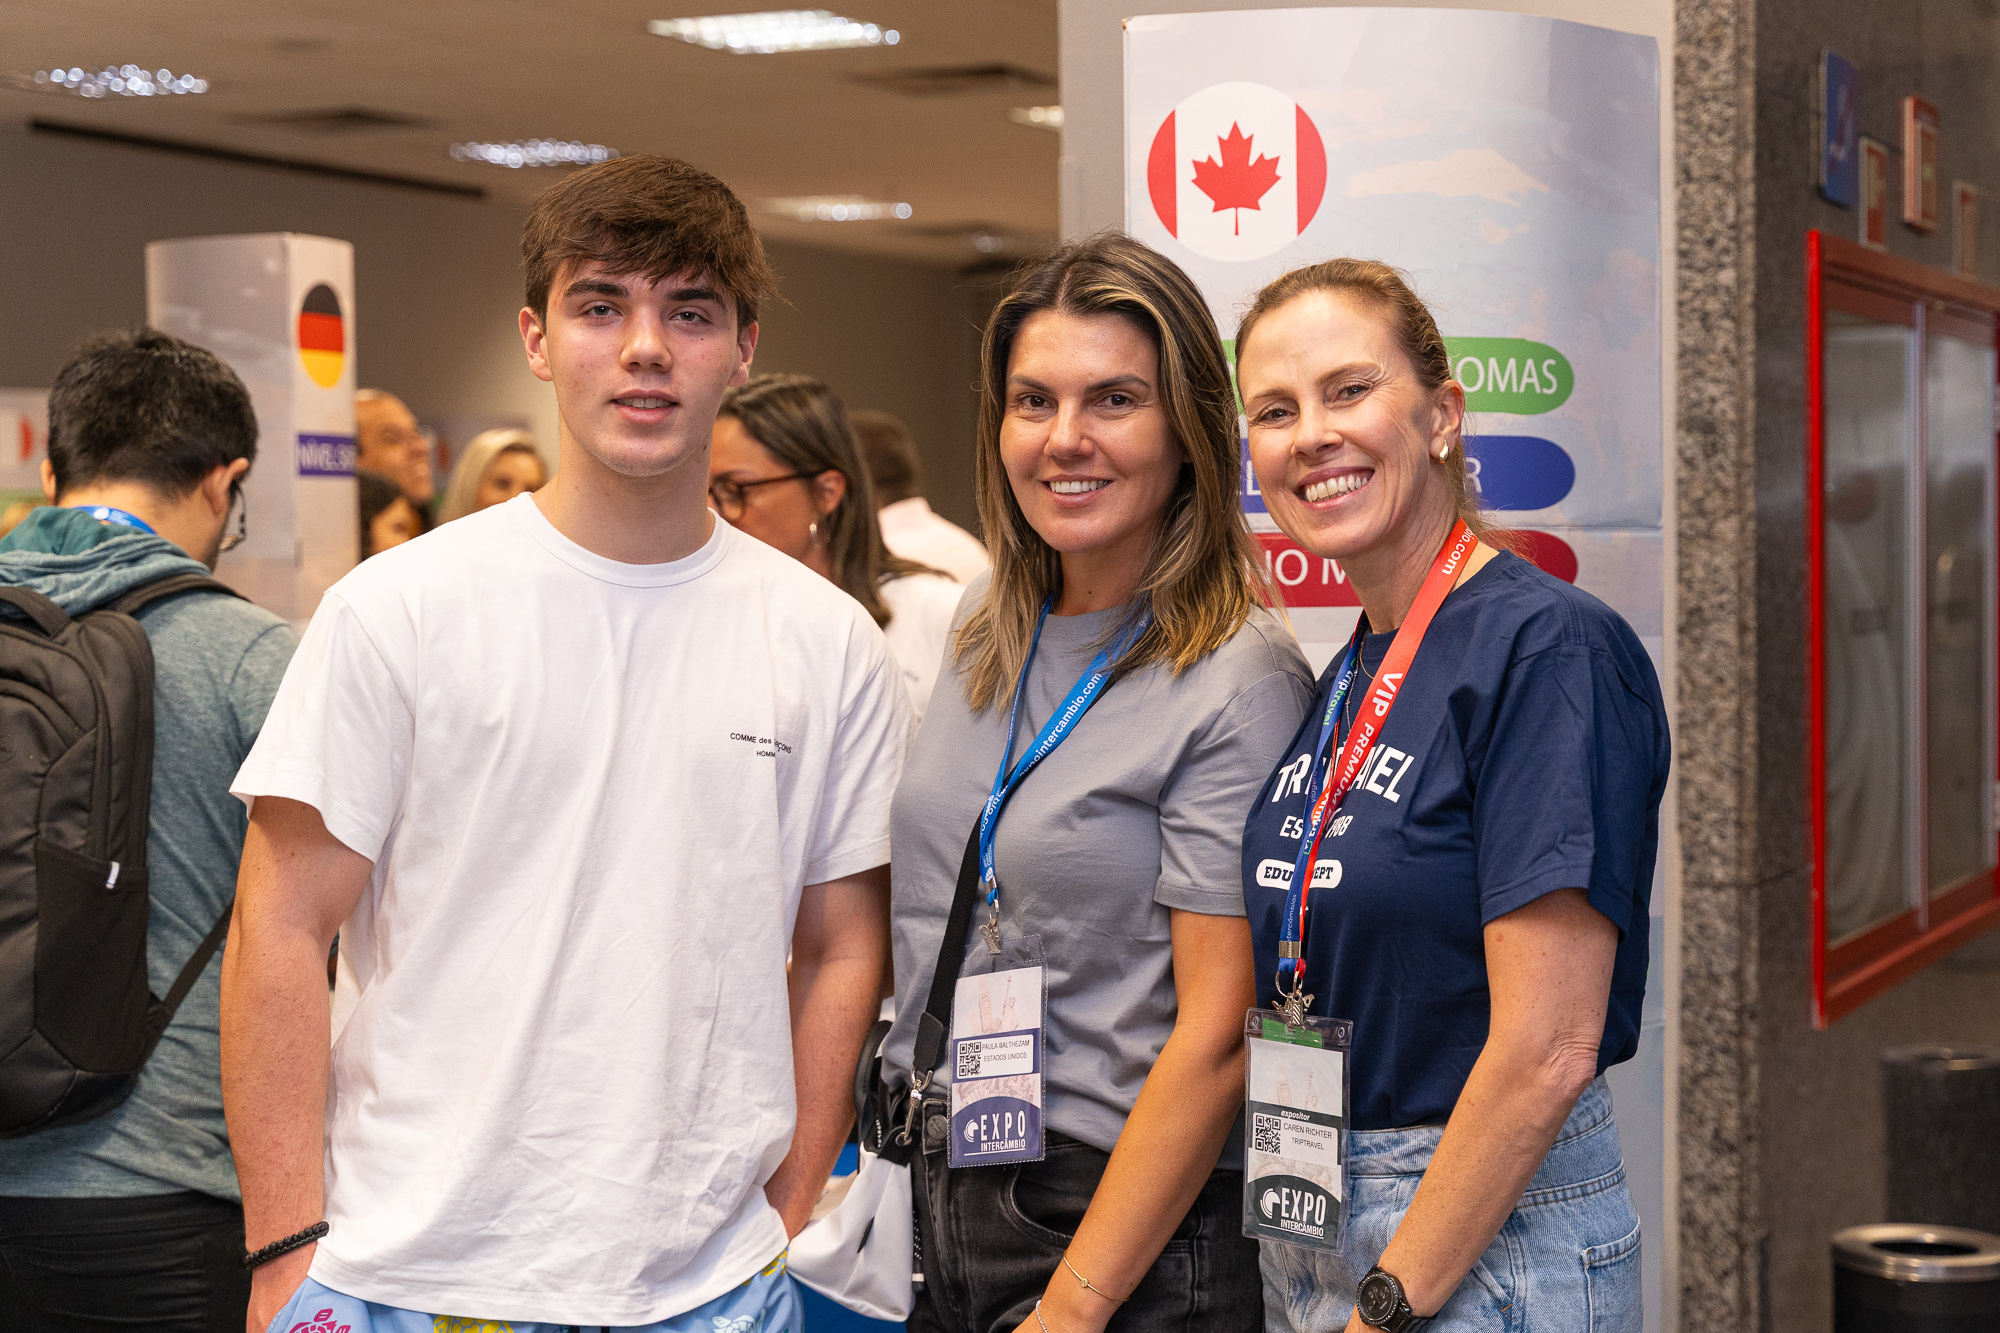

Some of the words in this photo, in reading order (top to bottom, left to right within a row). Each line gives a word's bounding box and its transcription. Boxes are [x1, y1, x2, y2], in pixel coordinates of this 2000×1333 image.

[1372, 671, 1404, 717] VIP
[730, 733, 756, 743] COMME
[1331, 721, 1376, 806] PREMIUM
[982, 1042, 998, 1050] PAULA
[999, 1040, 1030, 1049] BALTHEZAM
[984, 1053, 1007, 1062] ESTADOS
[1007, 1052, 1028, 1060] UNIDOS
[1281, 1110, 1310, 1120] expositor
[980, 1110, 1026, 1141] EXPO
[1283, 1122, 1304, 1133] CAREN
[1305, 1127, 1333, 1139] RICHTER
[980, 1138, 1026, 1152] INTERCÂMBIO
[1291, 1136, 1325, 1151] TRIPTRAVEL
[1281, 1187, 1327, 1226] EXPO
[1280, 1218, 1324, 1237] INTERCÂMBIO
